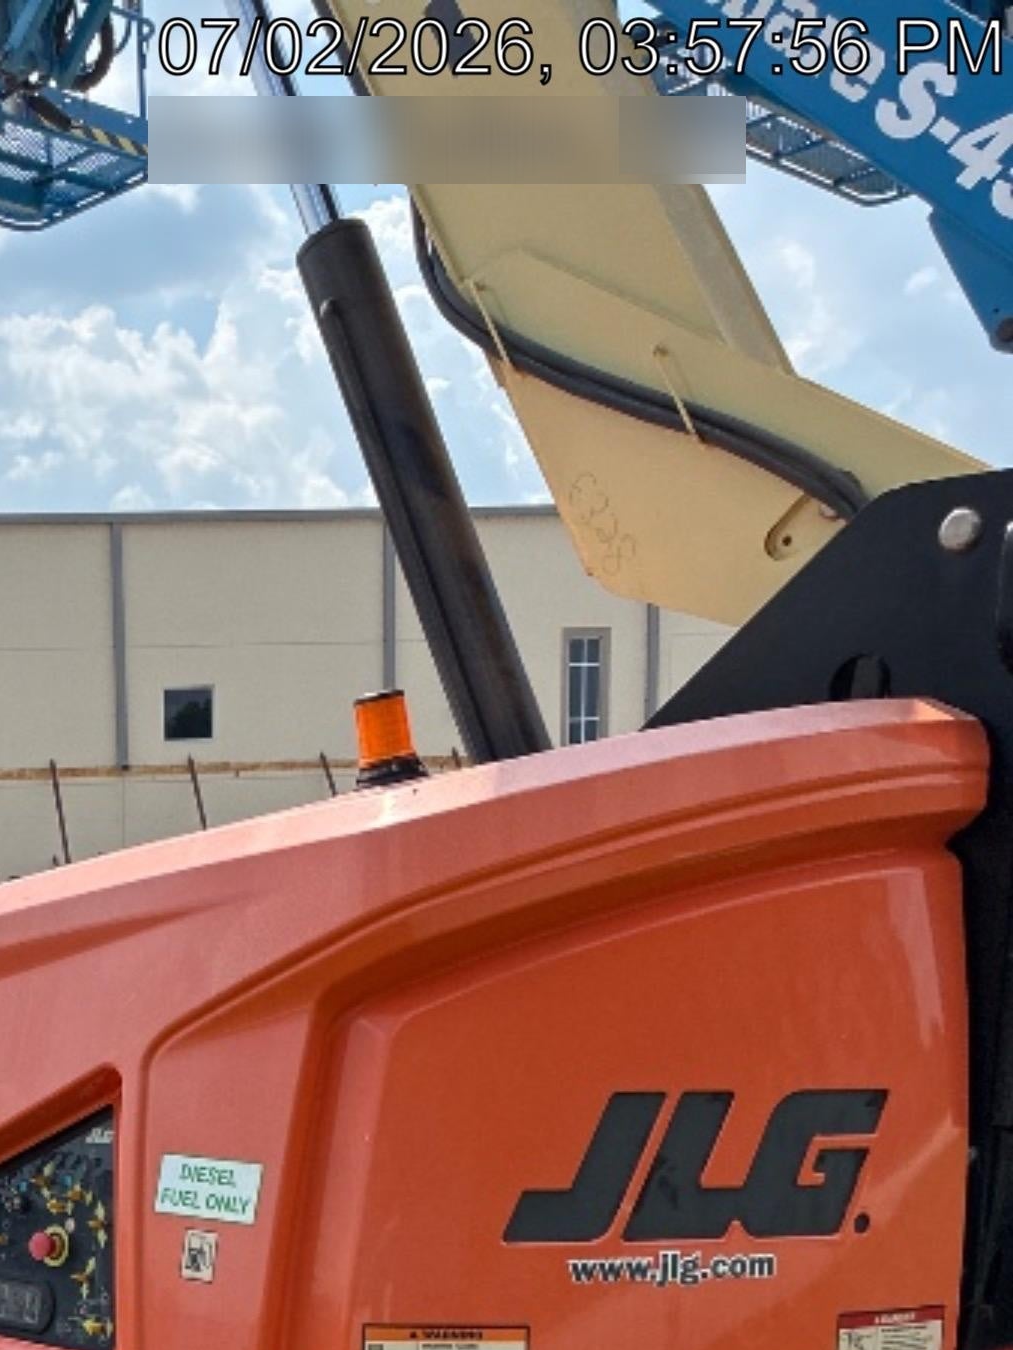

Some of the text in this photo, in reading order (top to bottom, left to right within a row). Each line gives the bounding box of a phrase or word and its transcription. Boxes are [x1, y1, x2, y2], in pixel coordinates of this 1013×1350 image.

[179, 1164, 236, 1187] DIESEL
[501, 1088, 889, 1244] JLG
[160, 1187, 251, 1215] FUEL ONLY
[569, 1251, 776, 1286] www.jlg.com
